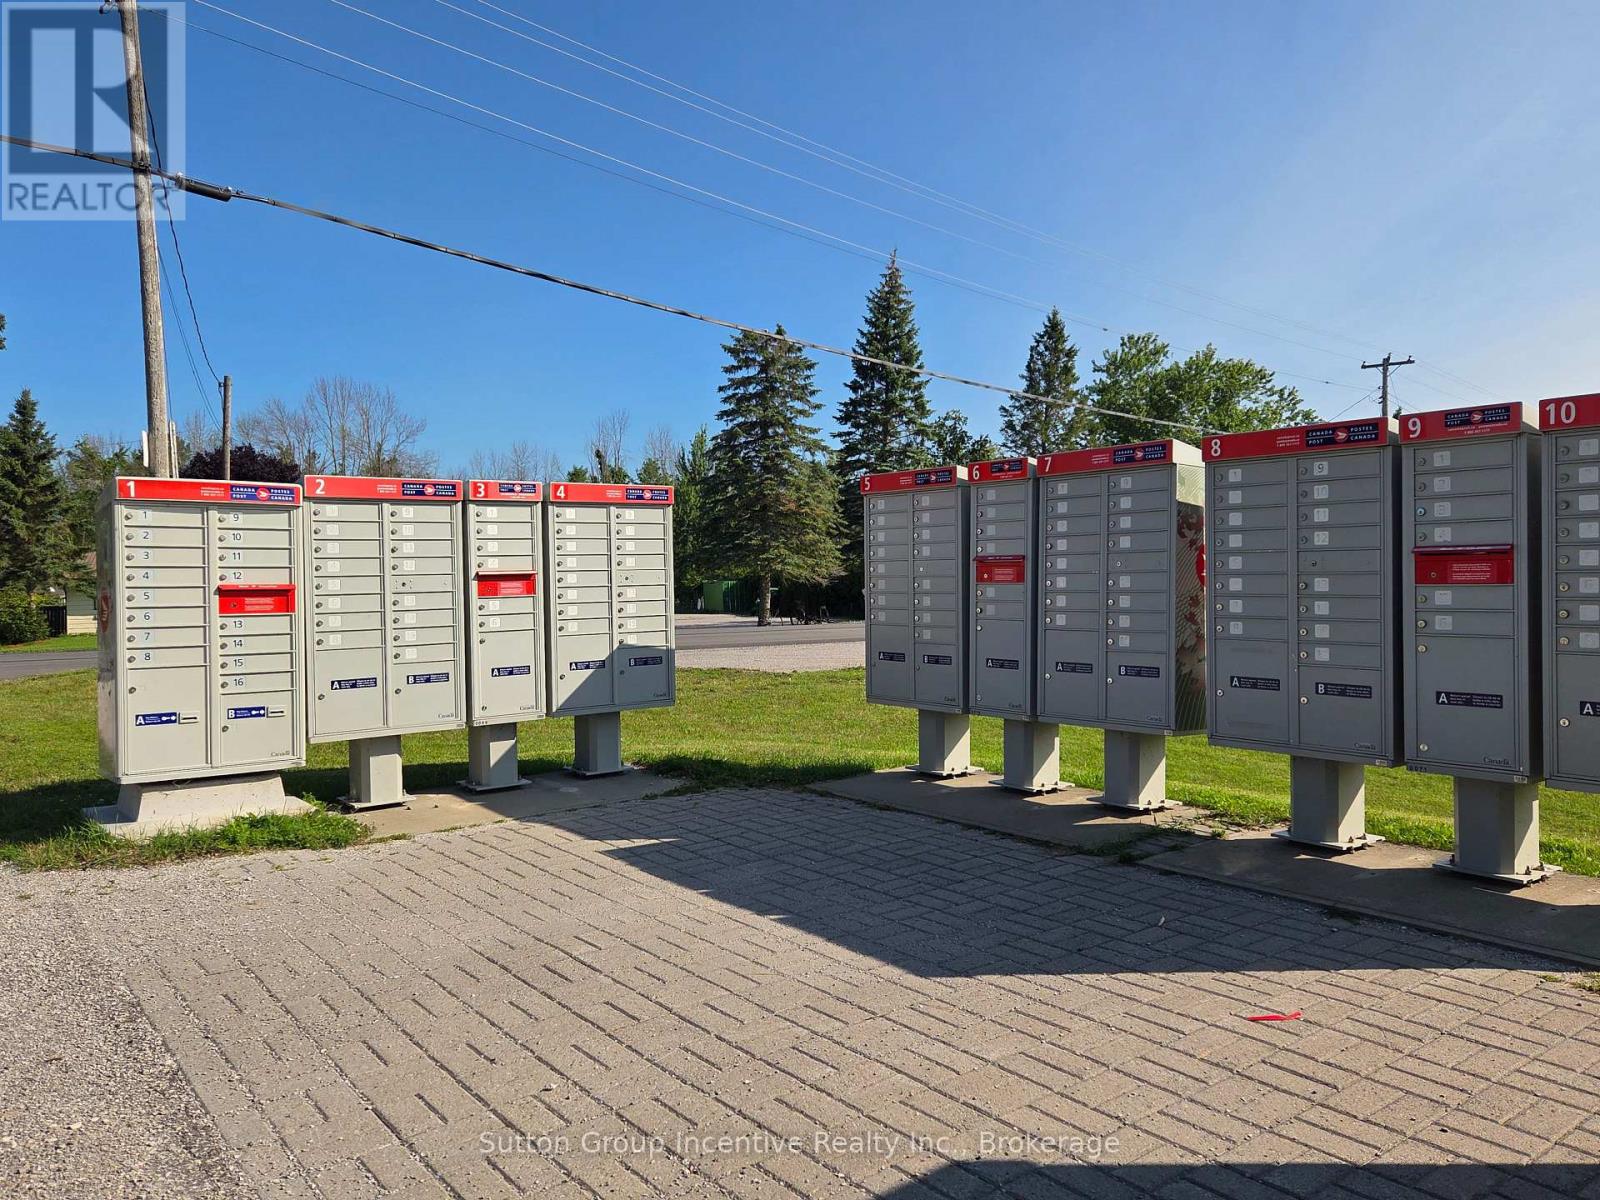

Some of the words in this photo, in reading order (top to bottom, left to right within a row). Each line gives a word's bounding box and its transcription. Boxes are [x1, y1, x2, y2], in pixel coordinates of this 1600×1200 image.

[1545, 402, 1575, 424] 10
[1408, 418, 1421, 438] 9
[1211, 439, 1220, 456] 8
[1044, 457, 1052, 472] 7
[1317, 463, 1323, 472] 9
[973, 466, 979, 479] 6
[127, 481, 135, 497] 1
[315, 479, 325, 494] 2
[864, 478, 870, 490] 5
[476, 484, 485, 497] 3
[557, 486, 565, 498] 4
[571, 662, 576, 670] A
[987, 659, 992, 667] A
[1057, 663, 1062, 671] A
[1232, 678, 1239, 687] A
[1318, 684, 1324, 693] B
[1439, 693, 1447, 703] A
[229, 710, 235, 718] B
[1583, 704, 1594, 715] A
[136, 716, 145, 725] A
